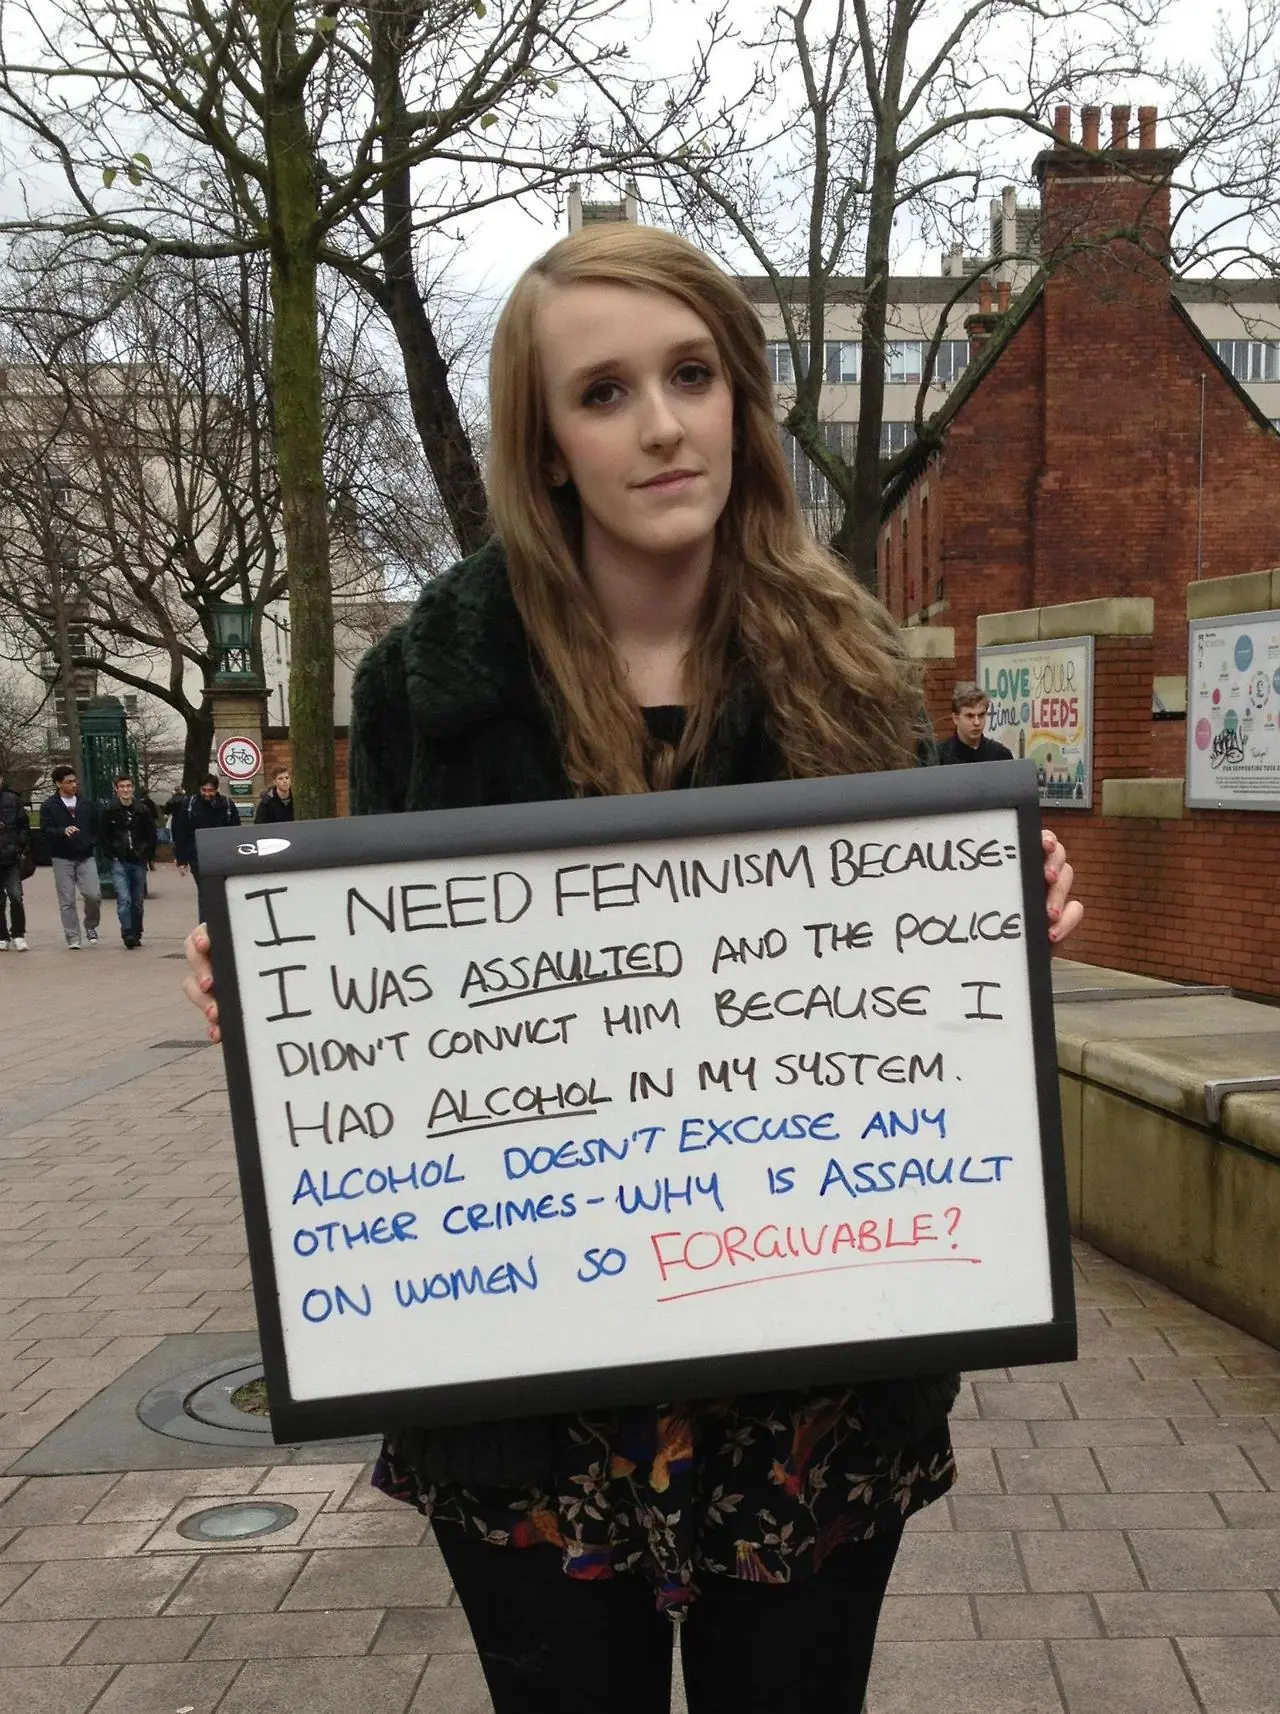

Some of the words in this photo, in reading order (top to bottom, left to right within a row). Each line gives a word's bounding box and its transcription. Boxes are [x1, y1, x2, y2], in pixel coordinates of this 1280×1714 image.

[985, 668, 1031, 701] LOVE
[987, 702, 1020, 732] time
[1031, 698, 1079, 729] LEEDS
[245, 886, 316, 947] I
[347, 871, 533, 936] NEED
[555, 844, 815, 917] FEMINISM
[258, 964, 313, 1023] I
[330, 963, 434, 1015] WAS
[460, 940, 683, 1000] ASSAULTED
[712, 928, 788, 975] AND
[803, 920, 874, 959] THE
[896, 910, 1022, 954] POLICE
[276, 1031, 410, 1078] DIDN'T
[428, 1013, 578, 1060] CONVICT
[603, 997, 681, 1038] HIM
[714, 984, 931, 1028] BECAUSE
[961, 981, 1003, 1020] I
[285, 1100, 395, 1148] HAD
[426, 1078, 613, 1130] ALCOHOL
[629, 1068, 675, 1103] IN
[699, 1056, 758, 1093] MY
[775, 1051, 962, 1087] SYSTEM.
[292, 1153, 466, 1207] ALCOHOL
[504, 1126, 666, 1181] DOESN'T
[679, 1112, 841, 1154] EXCUSE
[860, 1107, 947, 1140] ANY
[293, 1210, 418, 1258] OTHER
[767, 1166, 797, 1195] IS
[820, 1155, 1014, 1198] ASSAULT
[301, 1284, 373, 1324] ON
[395, 1255, 538, 1308] WOMEN
[577, 1247, 627, 1283] SO
[651, 1206, 962, 1281] FORGIVABLE?
